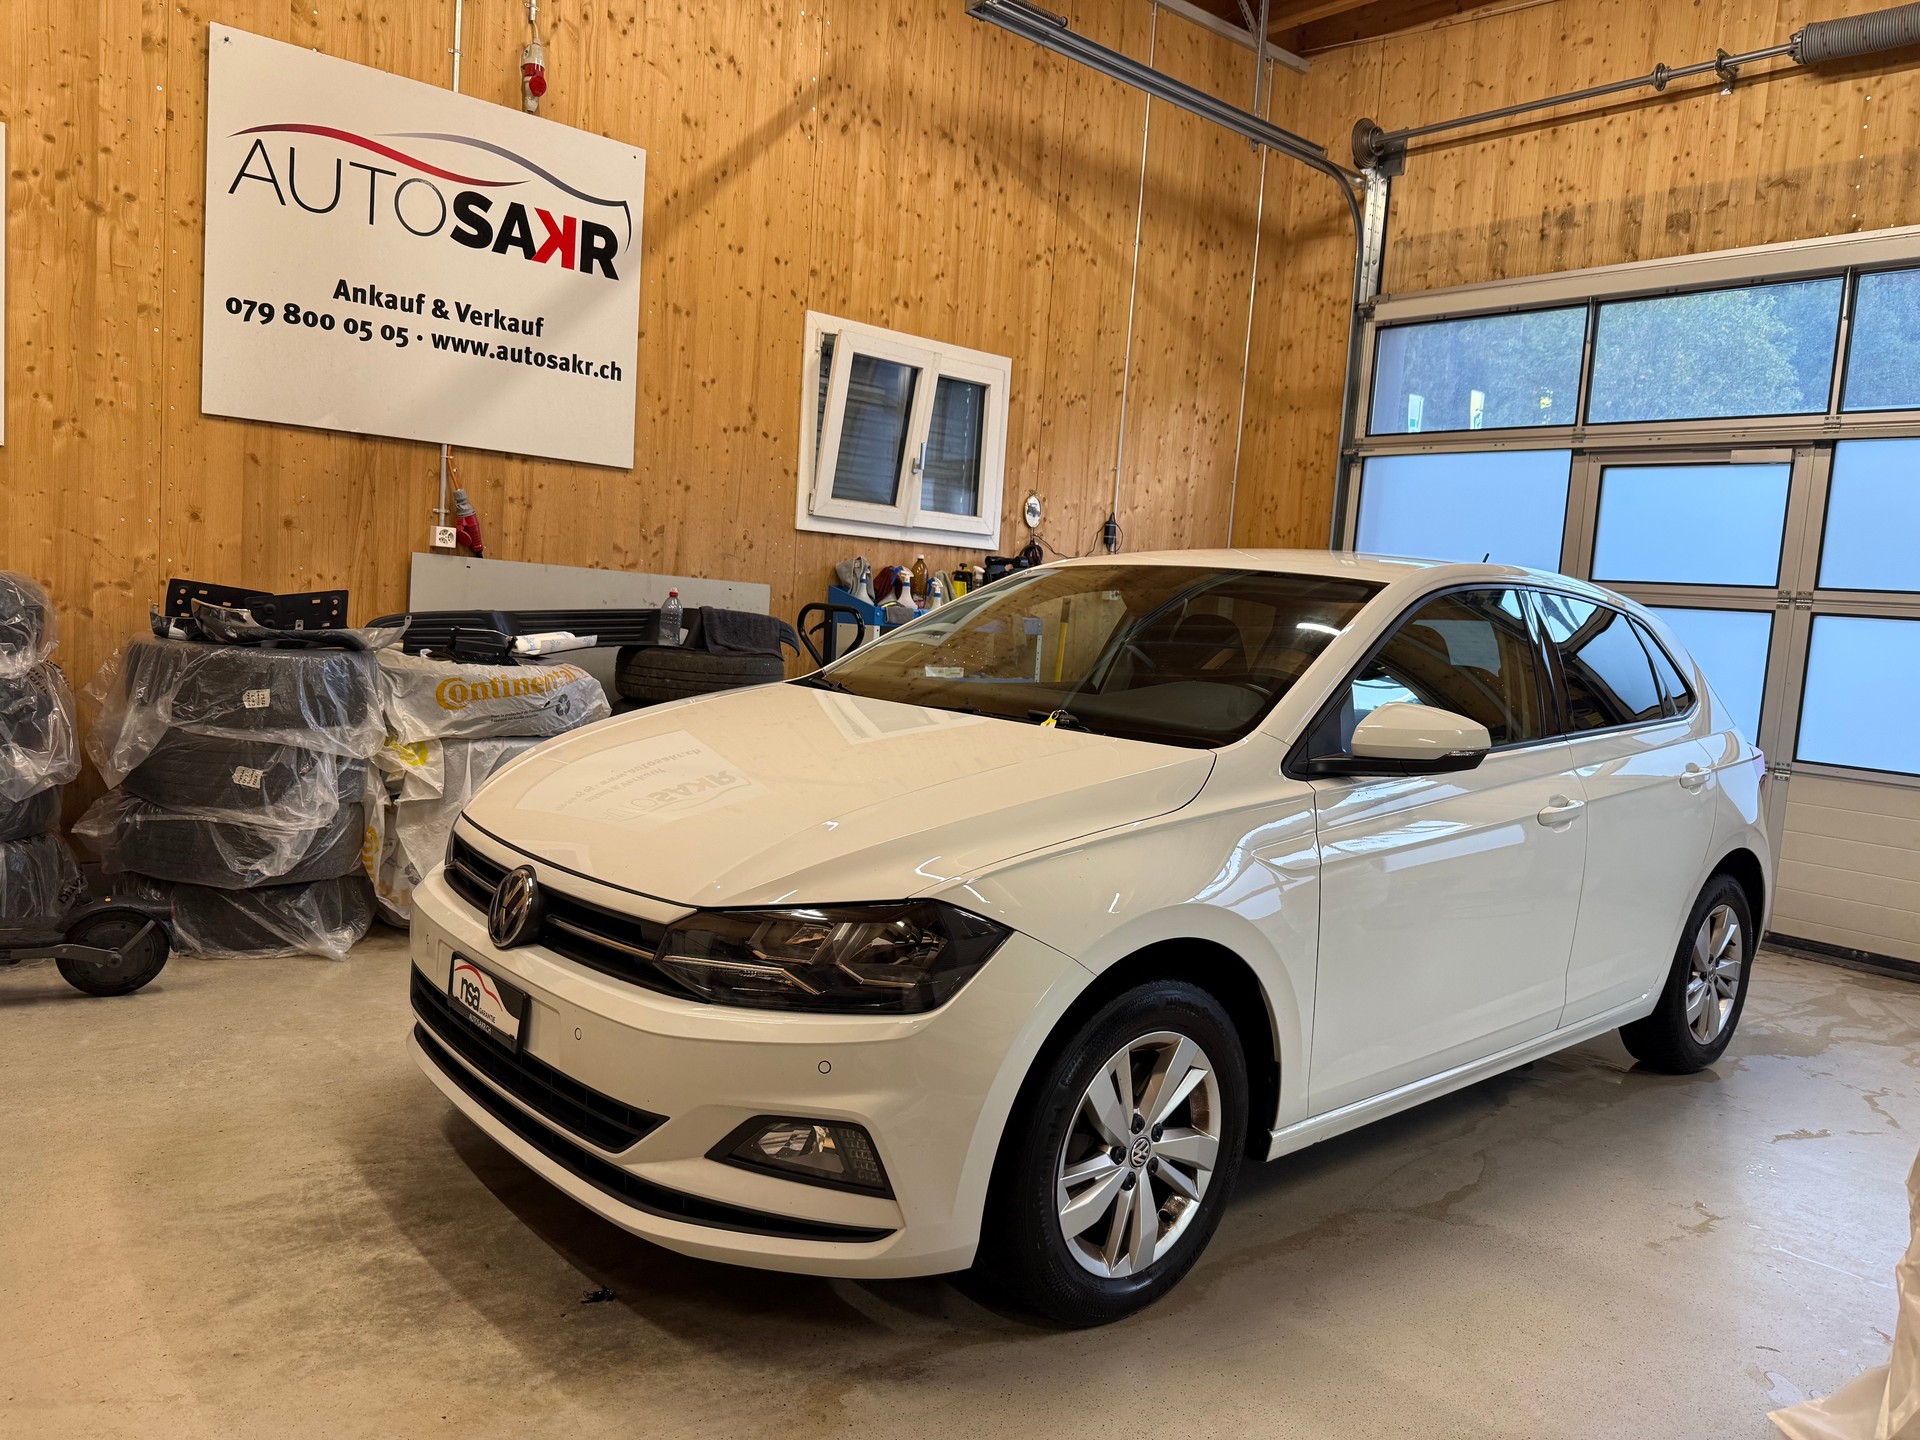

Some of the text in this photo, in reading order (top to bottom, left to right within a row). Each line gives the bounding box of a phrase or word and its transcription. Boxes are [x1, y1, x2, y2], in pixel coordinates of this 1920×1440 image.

[333, 279, 545, 338] Ankauf & Verkauf
[225, 297, 275, 325] 079
[283, 303, 336, 332] 800
[343, 317, 373, 342] 05
[380, 324, 409, 348] 05
[431, 331, 623, 382] www.autosakr.ch
[435, 665, 578, 711] Continental
[461, 976, 481, 1012] nsa
